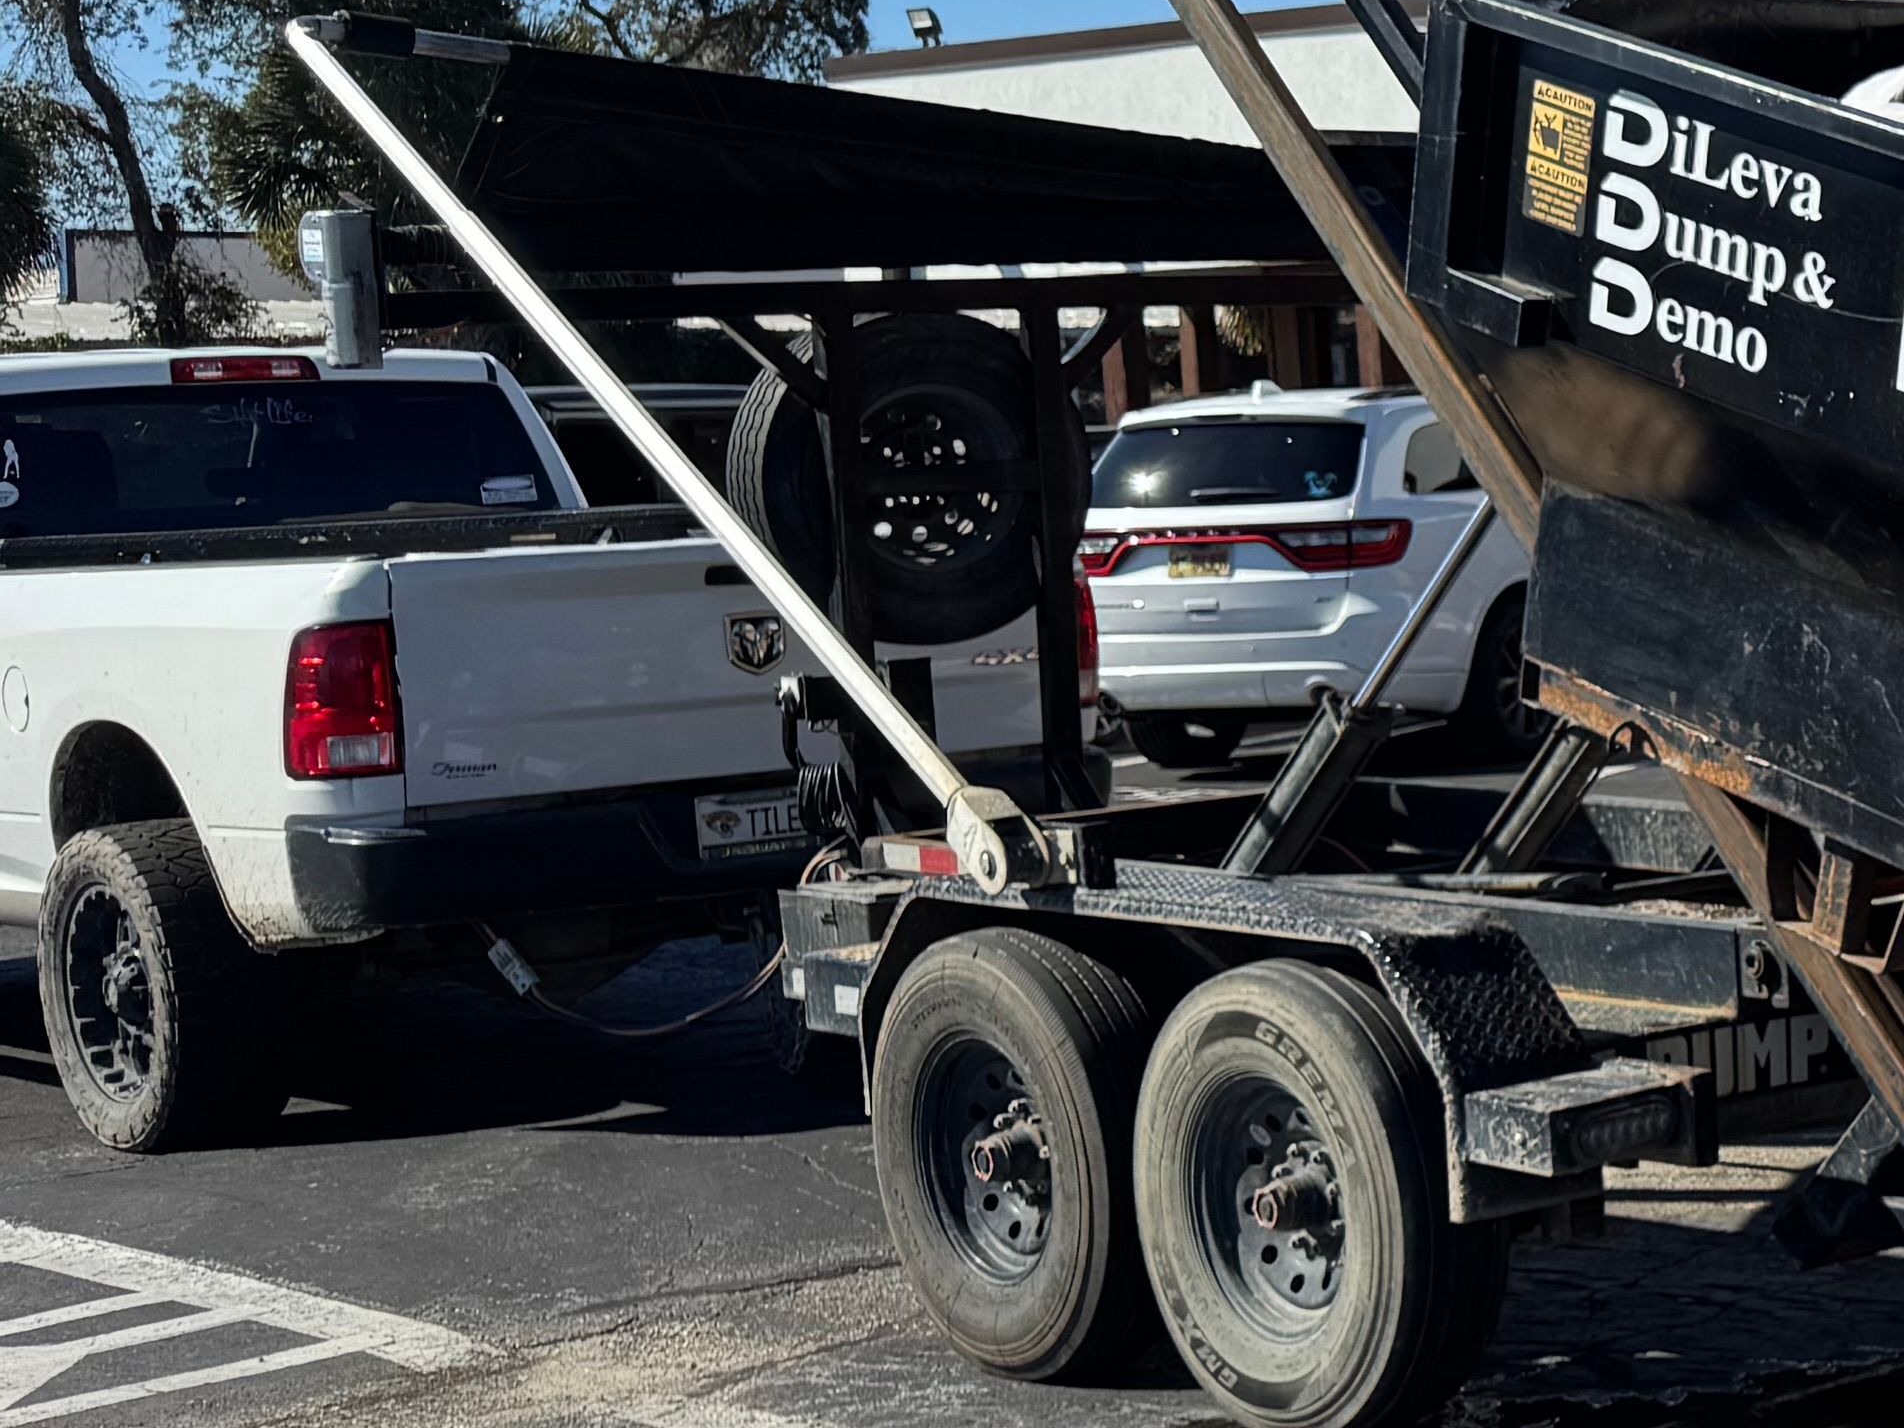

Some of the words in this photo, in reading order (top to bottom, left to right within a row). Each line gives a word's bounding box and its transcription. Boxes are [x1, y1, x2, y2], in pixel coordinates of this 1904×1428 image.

[1545, 89, 1593, 113] CAUTION
[1603, 89, 1822, 222] DiLeva
[1536, 163, 1585, 190] CAUTION
[1596, 172, 1787, 307] Dump
[1793, 251, 1836, 309] &
[1589, 256, 1768, 373] Demo
